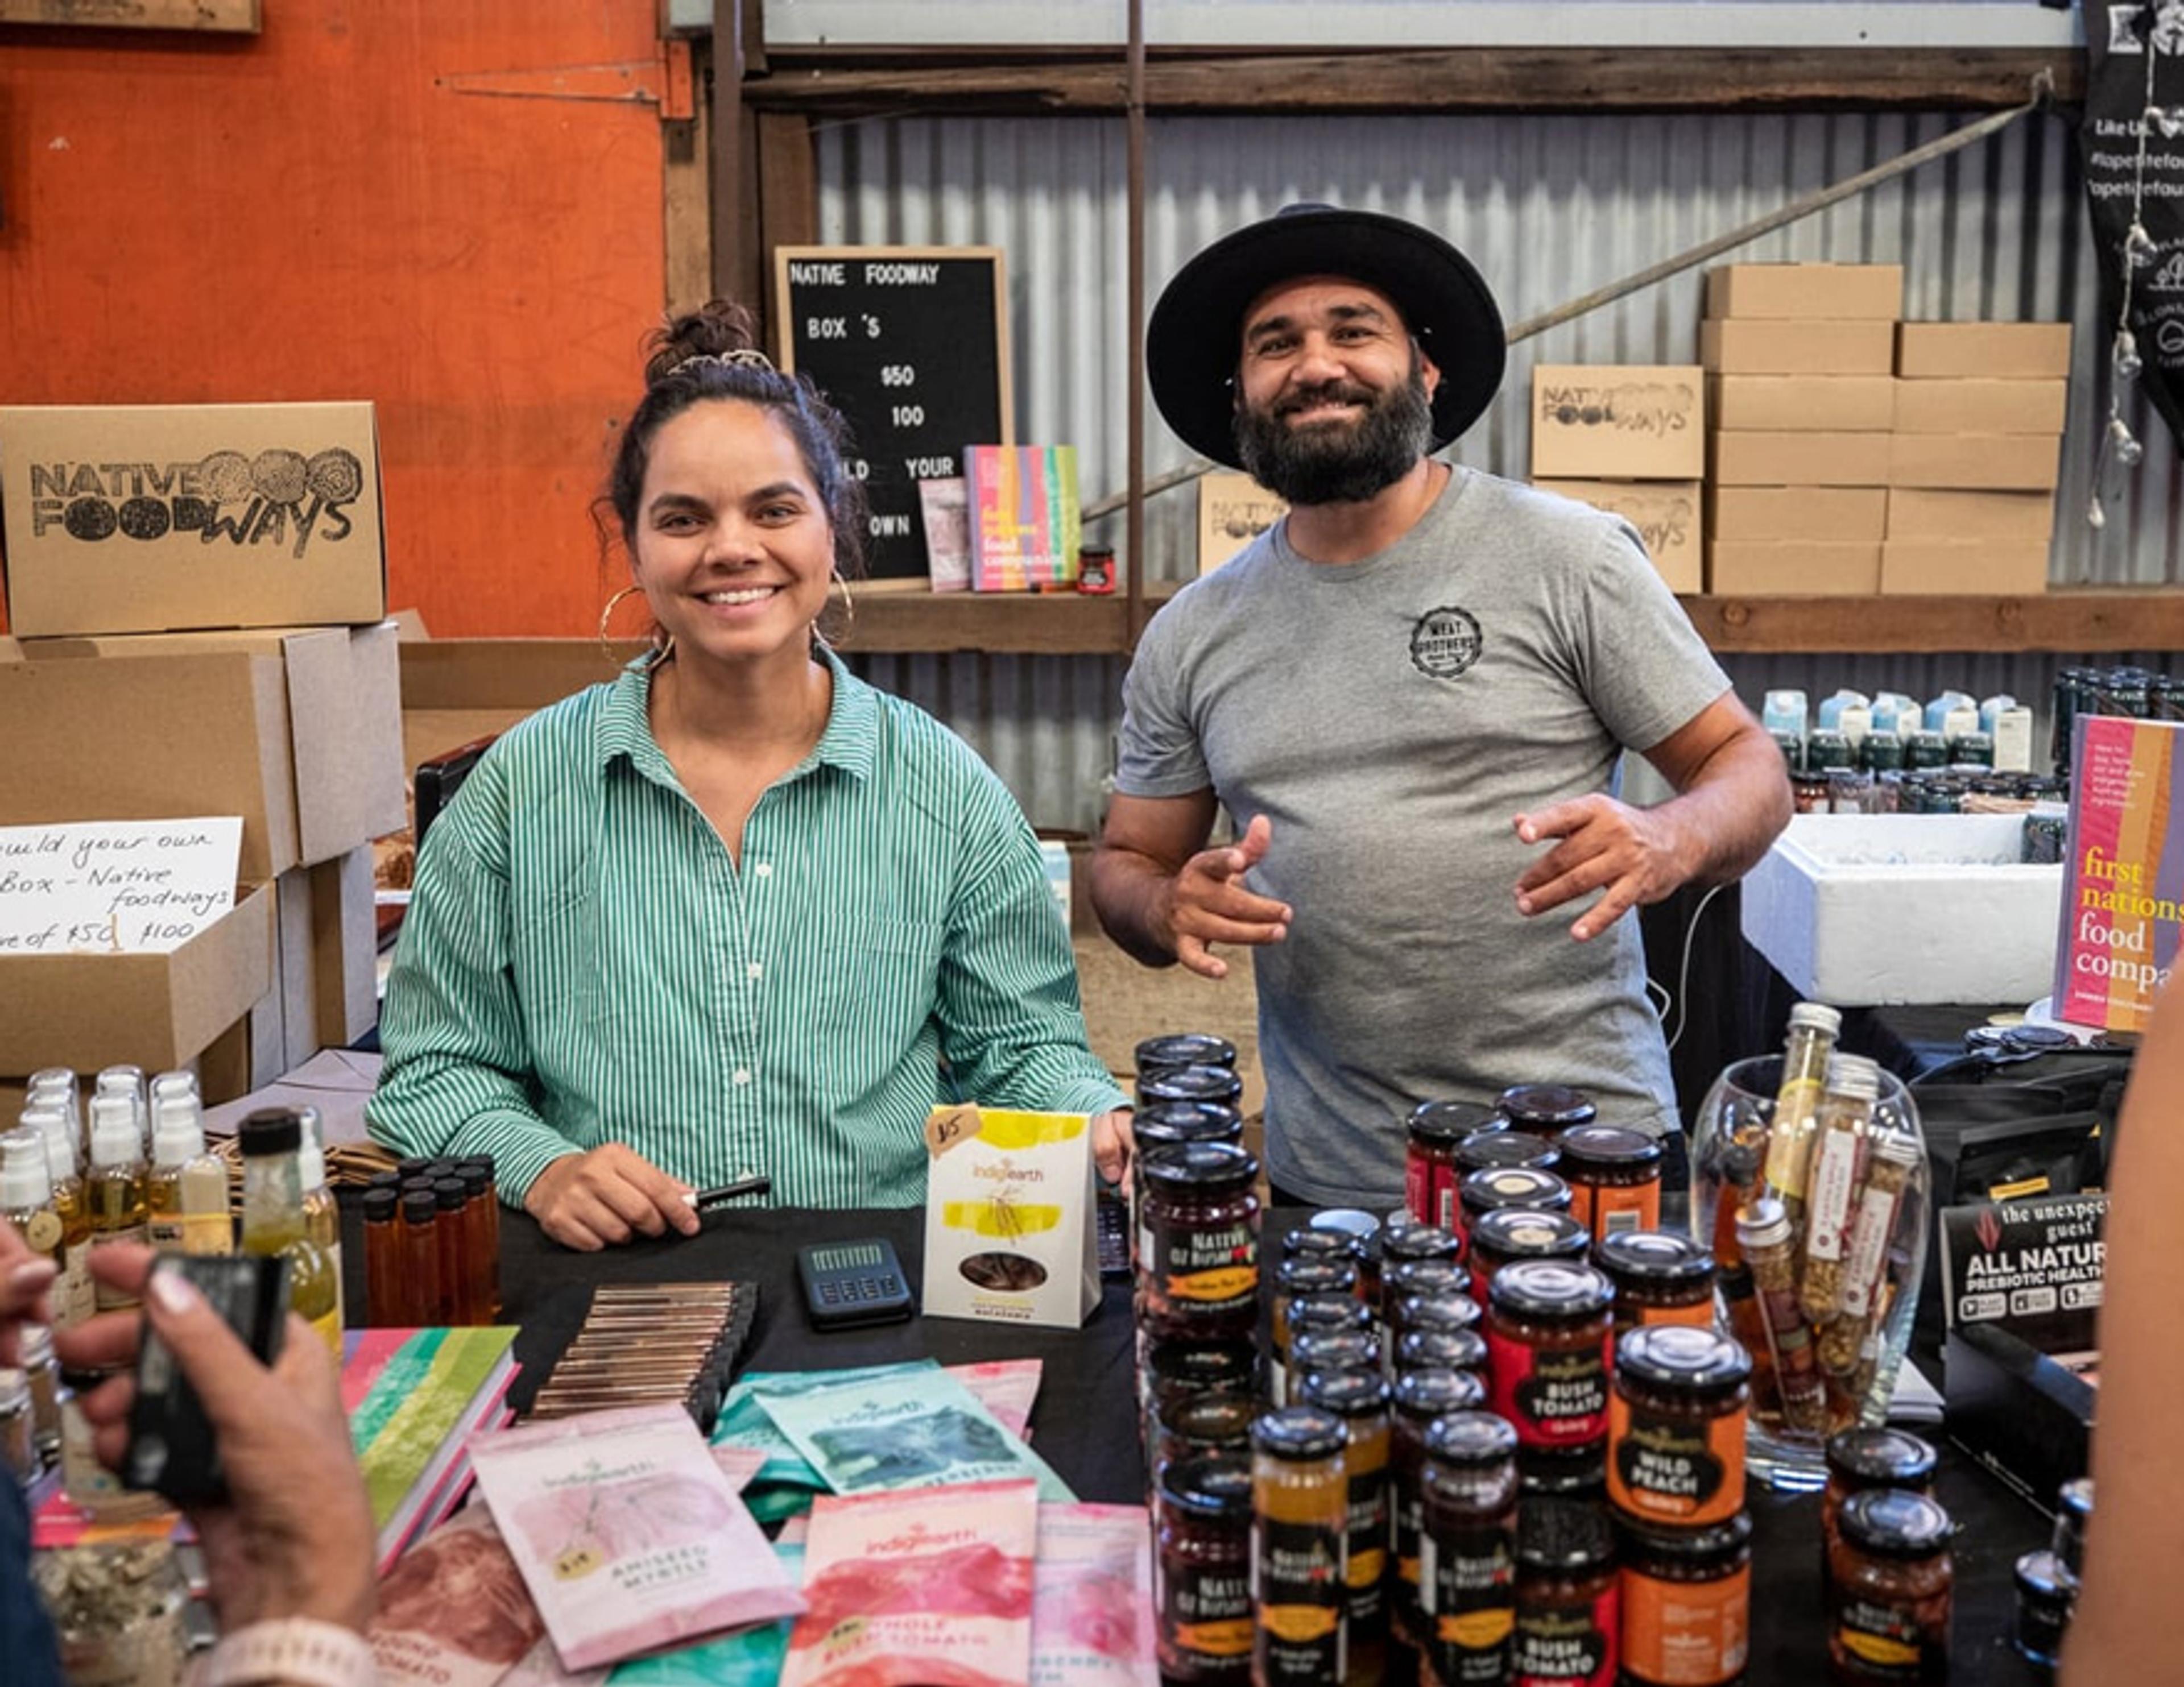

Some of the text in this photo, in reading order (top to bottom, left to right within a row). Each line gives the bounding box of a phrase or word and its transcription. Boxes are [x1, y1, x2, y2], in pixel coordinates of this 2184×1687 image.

[790, 263, 940, 285] NATIVE FOODWAY
[808, 317, 847, 338] BOX
[881, 365, 914, 386] $50
[892, 405, 924, 426] 100
[906, 457, 954, 477] YOUR
[31, 462, 202, 497] NATIVE
[870, 516, 909, 536] OWN
[72, 836, 147, 869] your
[158, 835, 212, 847] own
[2084, 845, 2142, 884] first
[0, 870, 53, 893] Box
[88, 868, 172, 887] Native
[107, 887, 229, 917] foodways
[26, 922, 60, 948] of
[67, 922, 114, 944] $50
[140, 922, 195, 945] $100
[2079, 910, 2145, 952] food
[2001, 1205, 2030, 1224] the
[2046, 1221, 2094, 1244] guest
[1967, 1251, 2017, 1278] ALL
[1966, 1271, 2046, 1293] PREBIOTIC
[1546, 1380, 1595, 1399] BUSH
[1532, 1393, 1603, 1417] TOMATO
[1639, 1449, 1691, 1475] WILD
[1631, 1466, 1698, 1494] PEACH
[1525, 1639, 1581, 1657] BUSH
